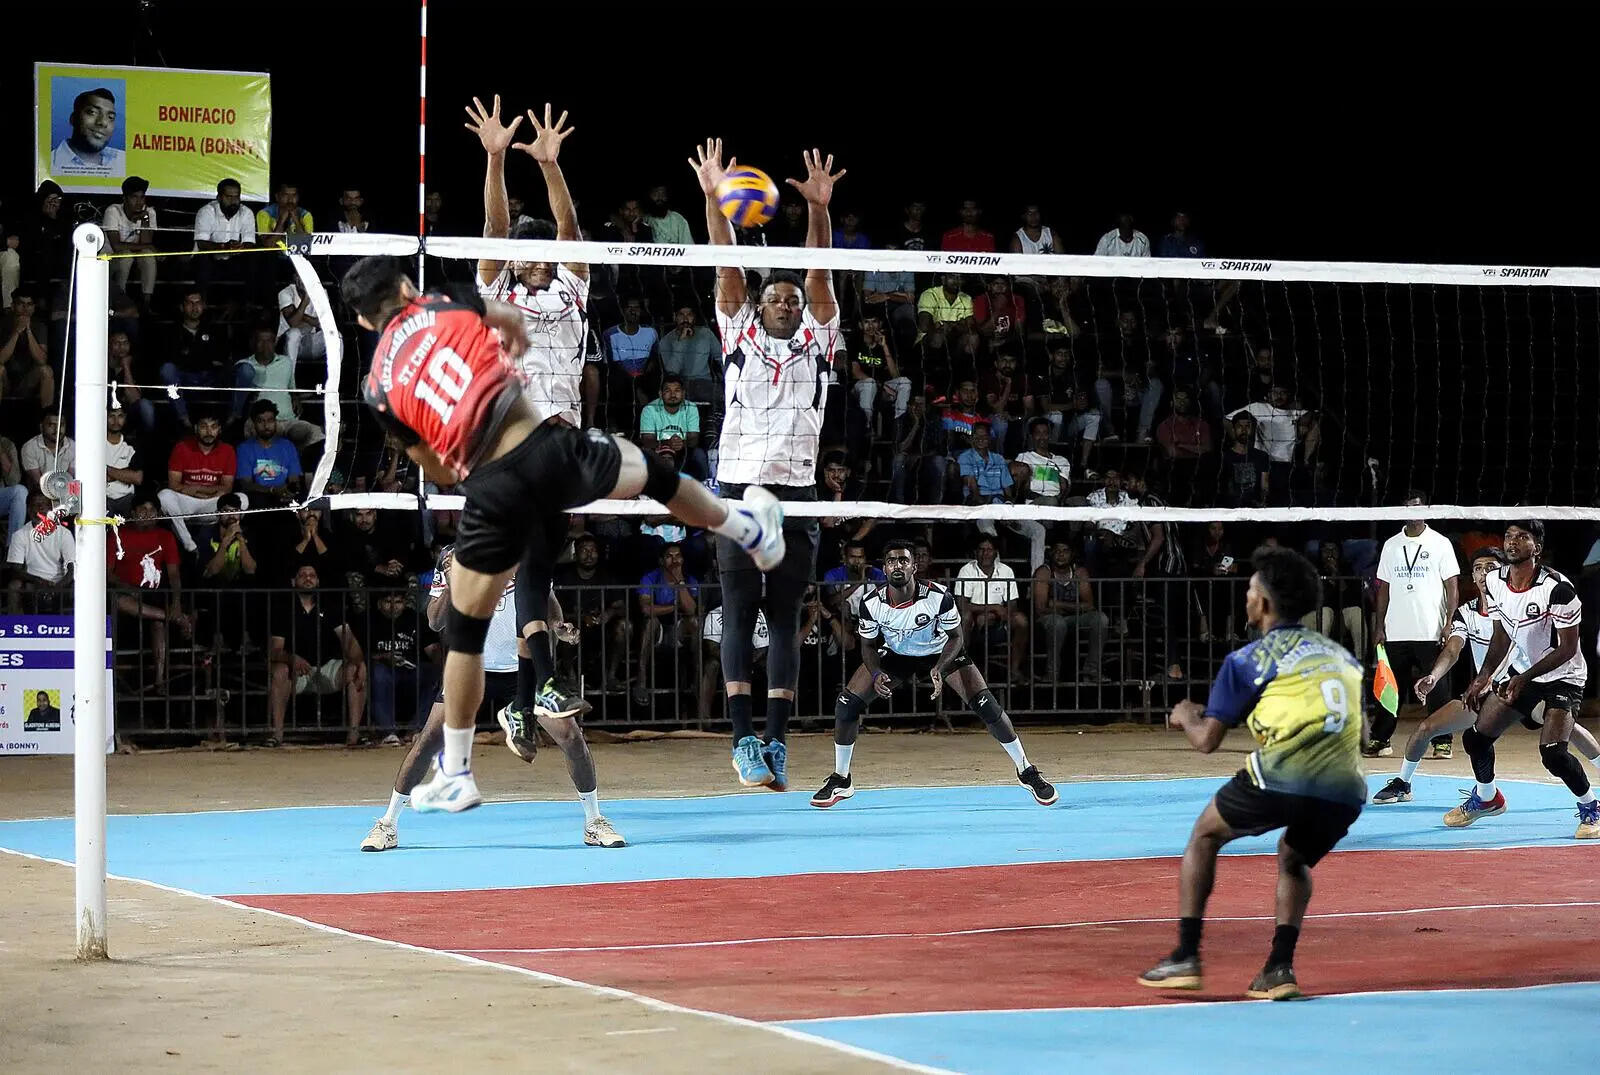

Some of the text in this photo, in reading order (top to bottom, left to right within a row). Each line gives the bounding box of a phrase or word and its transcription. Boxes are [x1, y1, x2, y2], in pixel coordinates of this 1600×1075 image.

[158, 106, 236, 125] BONIFACIO
[132, 134, 196, 153] ALMEIDA
[628, 246, 686, 257] SPARTAN
[946, 255, 1001, 266] SPARTAN
[1220, 261, 1272, 272] SPARTAN
[1500, 268, 1551, 279] SPARTAN
[411, 331, 438, 366] CRUZ
[413, 346, 474, 426] 10
[13, 624, 33, 635] St.
[37, 624, 71, 635] Cruz
[1320, 678, 1347, 734] 9
[6, 742, 39, 751] (BONNY)
